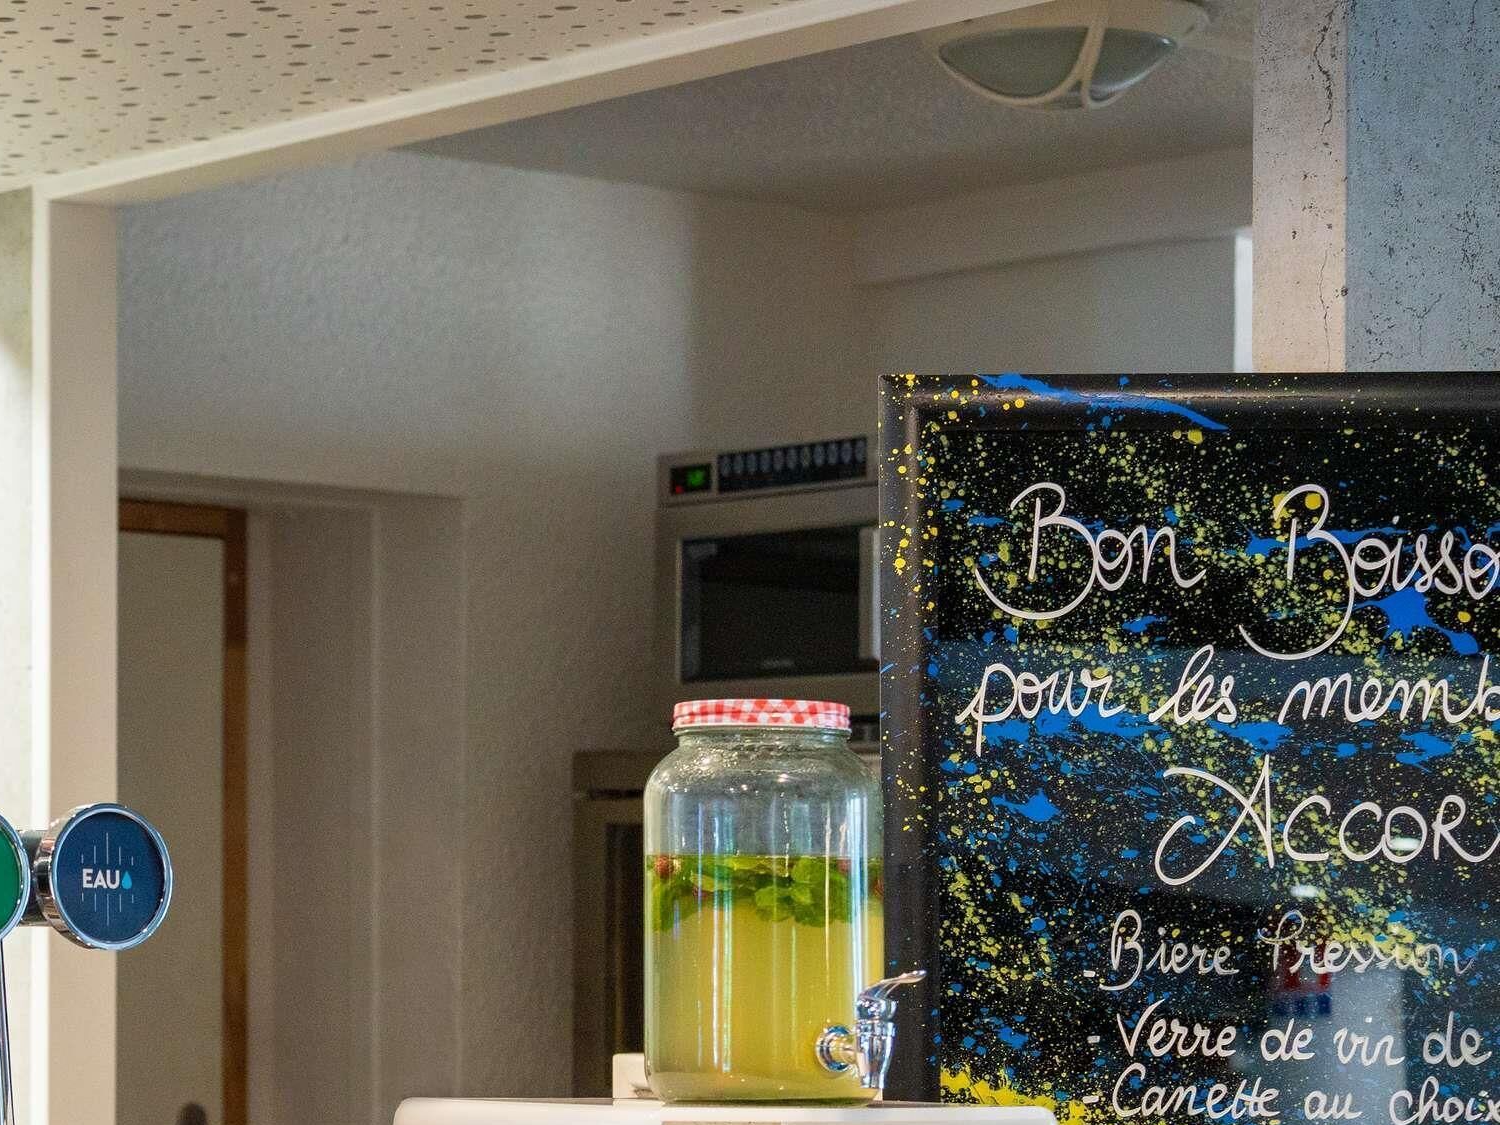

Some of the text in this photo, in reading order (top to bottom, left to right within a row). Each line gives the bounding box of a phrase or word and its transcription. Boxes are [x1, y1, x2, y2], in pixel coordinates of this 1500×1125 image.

[974, 482, 1207, 620] Bon
[956, 662, 1127, 757] pour
[1149, 644, 1239, 726] les
[82, 869, 120, 889] EAU
[1116, 999, 1493, 1068] Verre de vin de
[1112, 1062, 1280, 1121] Canette
[1304, 1091, 1363, 1121] au
